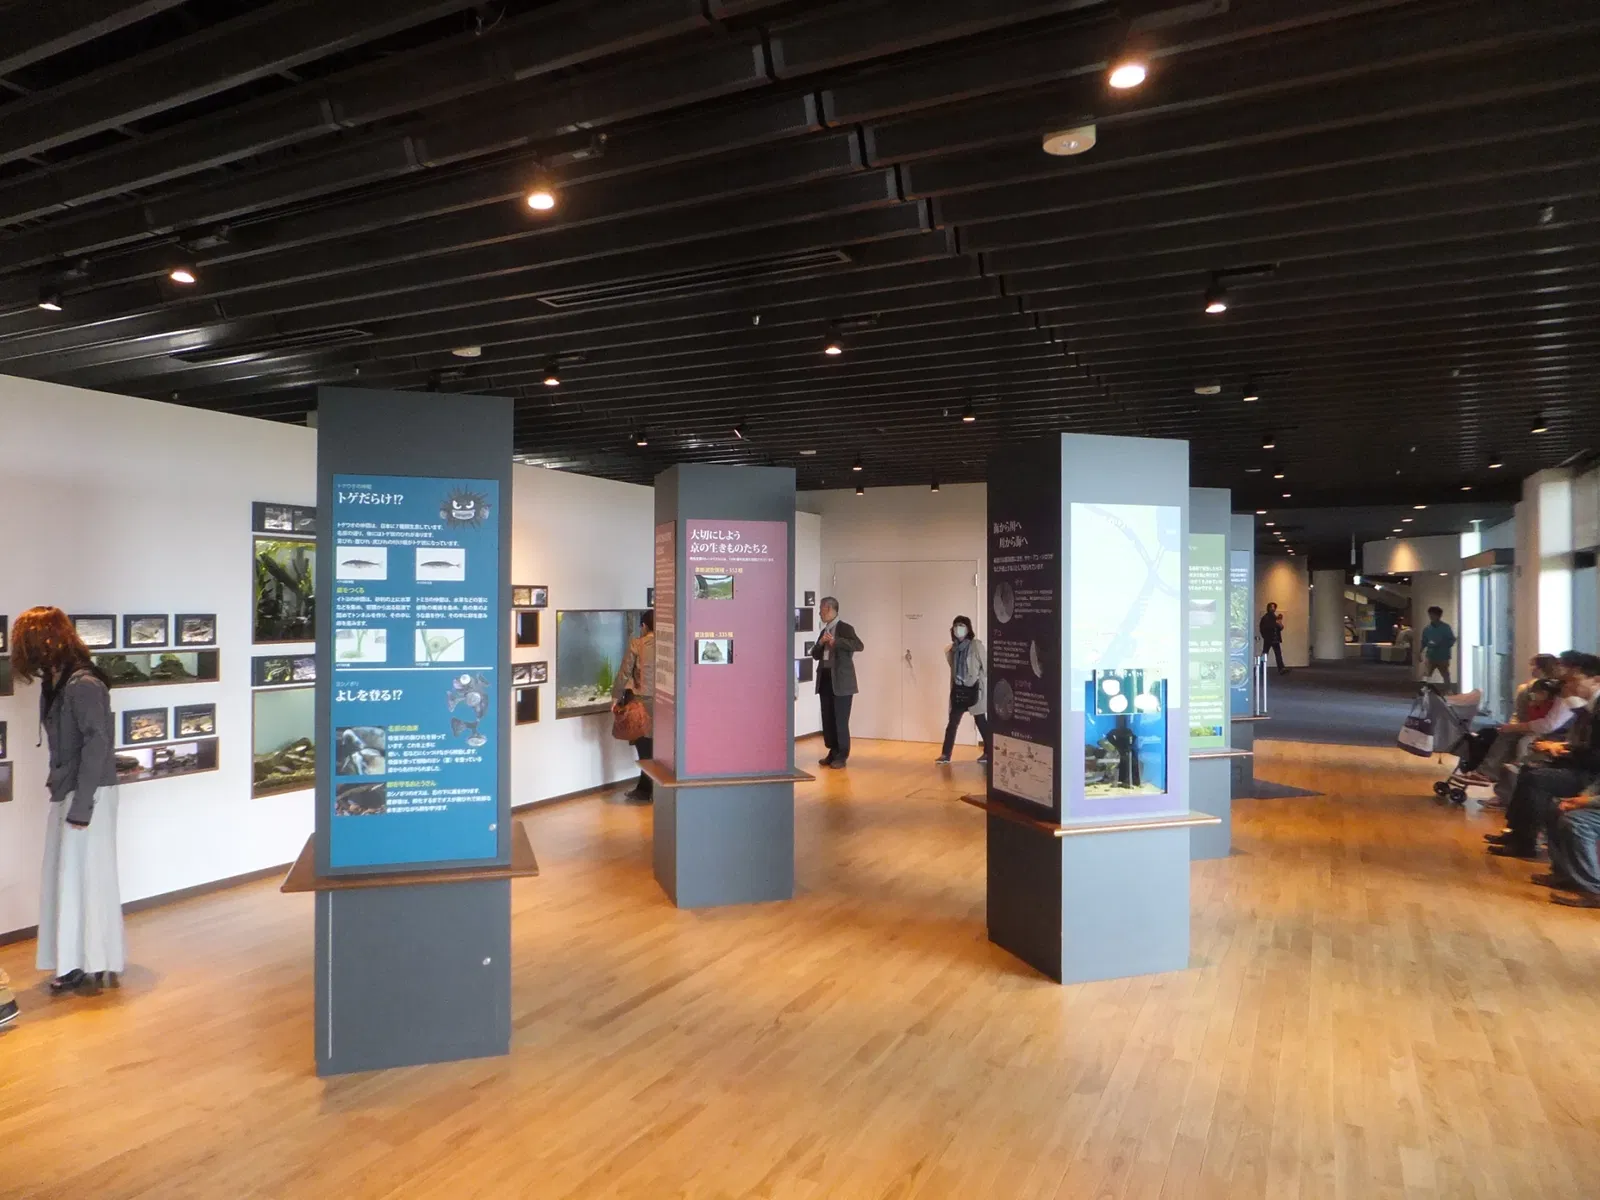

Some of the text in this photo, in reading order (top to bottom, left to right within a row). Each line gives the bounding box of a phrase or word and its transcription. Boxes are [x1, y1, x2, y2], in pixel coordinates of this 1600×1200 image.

[690, 529, 741, 540] 大切にしよう
